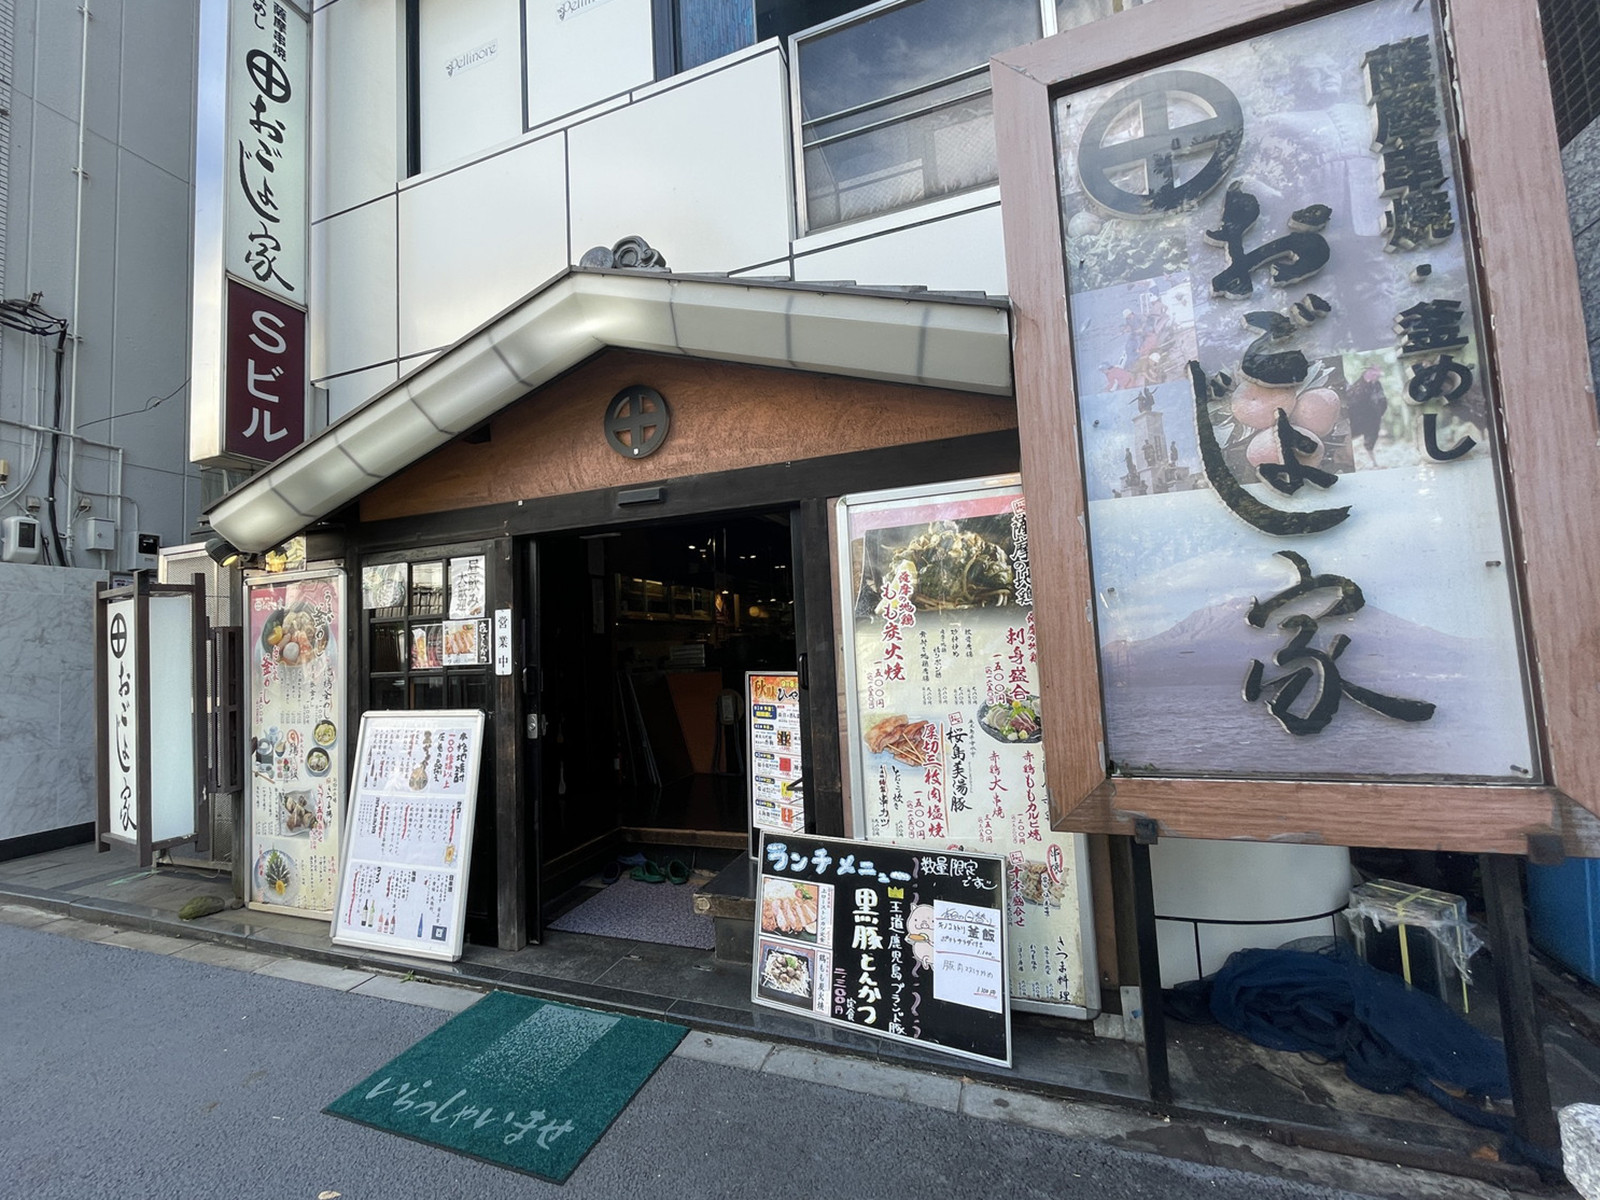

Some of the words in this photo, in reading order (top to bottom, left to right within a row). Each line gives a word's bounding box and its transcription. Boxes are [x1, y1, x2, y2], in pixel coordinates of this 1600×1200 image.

[252, 0, 267, 30] めし
[273, 1, 287, 62] 薩摩串焼
[446, 44, 497, 77] Pellinore
[239, 94, 295, 292] おごじょ家
[242, 310, 289, 443] Sビル
[882, 584, 905, 681] もも炭火焼
[899, 571, 915, 626] 薩摩の地鶏
[498, 615, 509, 668] 営業中
[1006, 627, 1031, 700] 刺身盛合
[874, 660, 885, 708] 一五〇〇円
[922, 723, 945, 839] 厚切三枚肉塩焼
[946, 727, 973, 814] 桜島美湯豚
[988, 750, 1008, 819] 赤鶏大串焼
[1022, 750, 1042, 841] 赤鶏ももカルビ焼
[914, 790, 926, 840] 一五〇〇円
[766, 843, 912, 884] ランチメニュー
[920, 856, 979, 877] 数量限定
[1008, 865, 1026, 927] 十本盛合せ
[851, 887, 883, 1025] 黒豚とんかつ
[887, 901, 907, 1036] 王道鹿児島ブランド豚
[1055, 935, 1072, 1002] さつま料理
[364, 1076, 575, 1149] いらっしゃいませ
